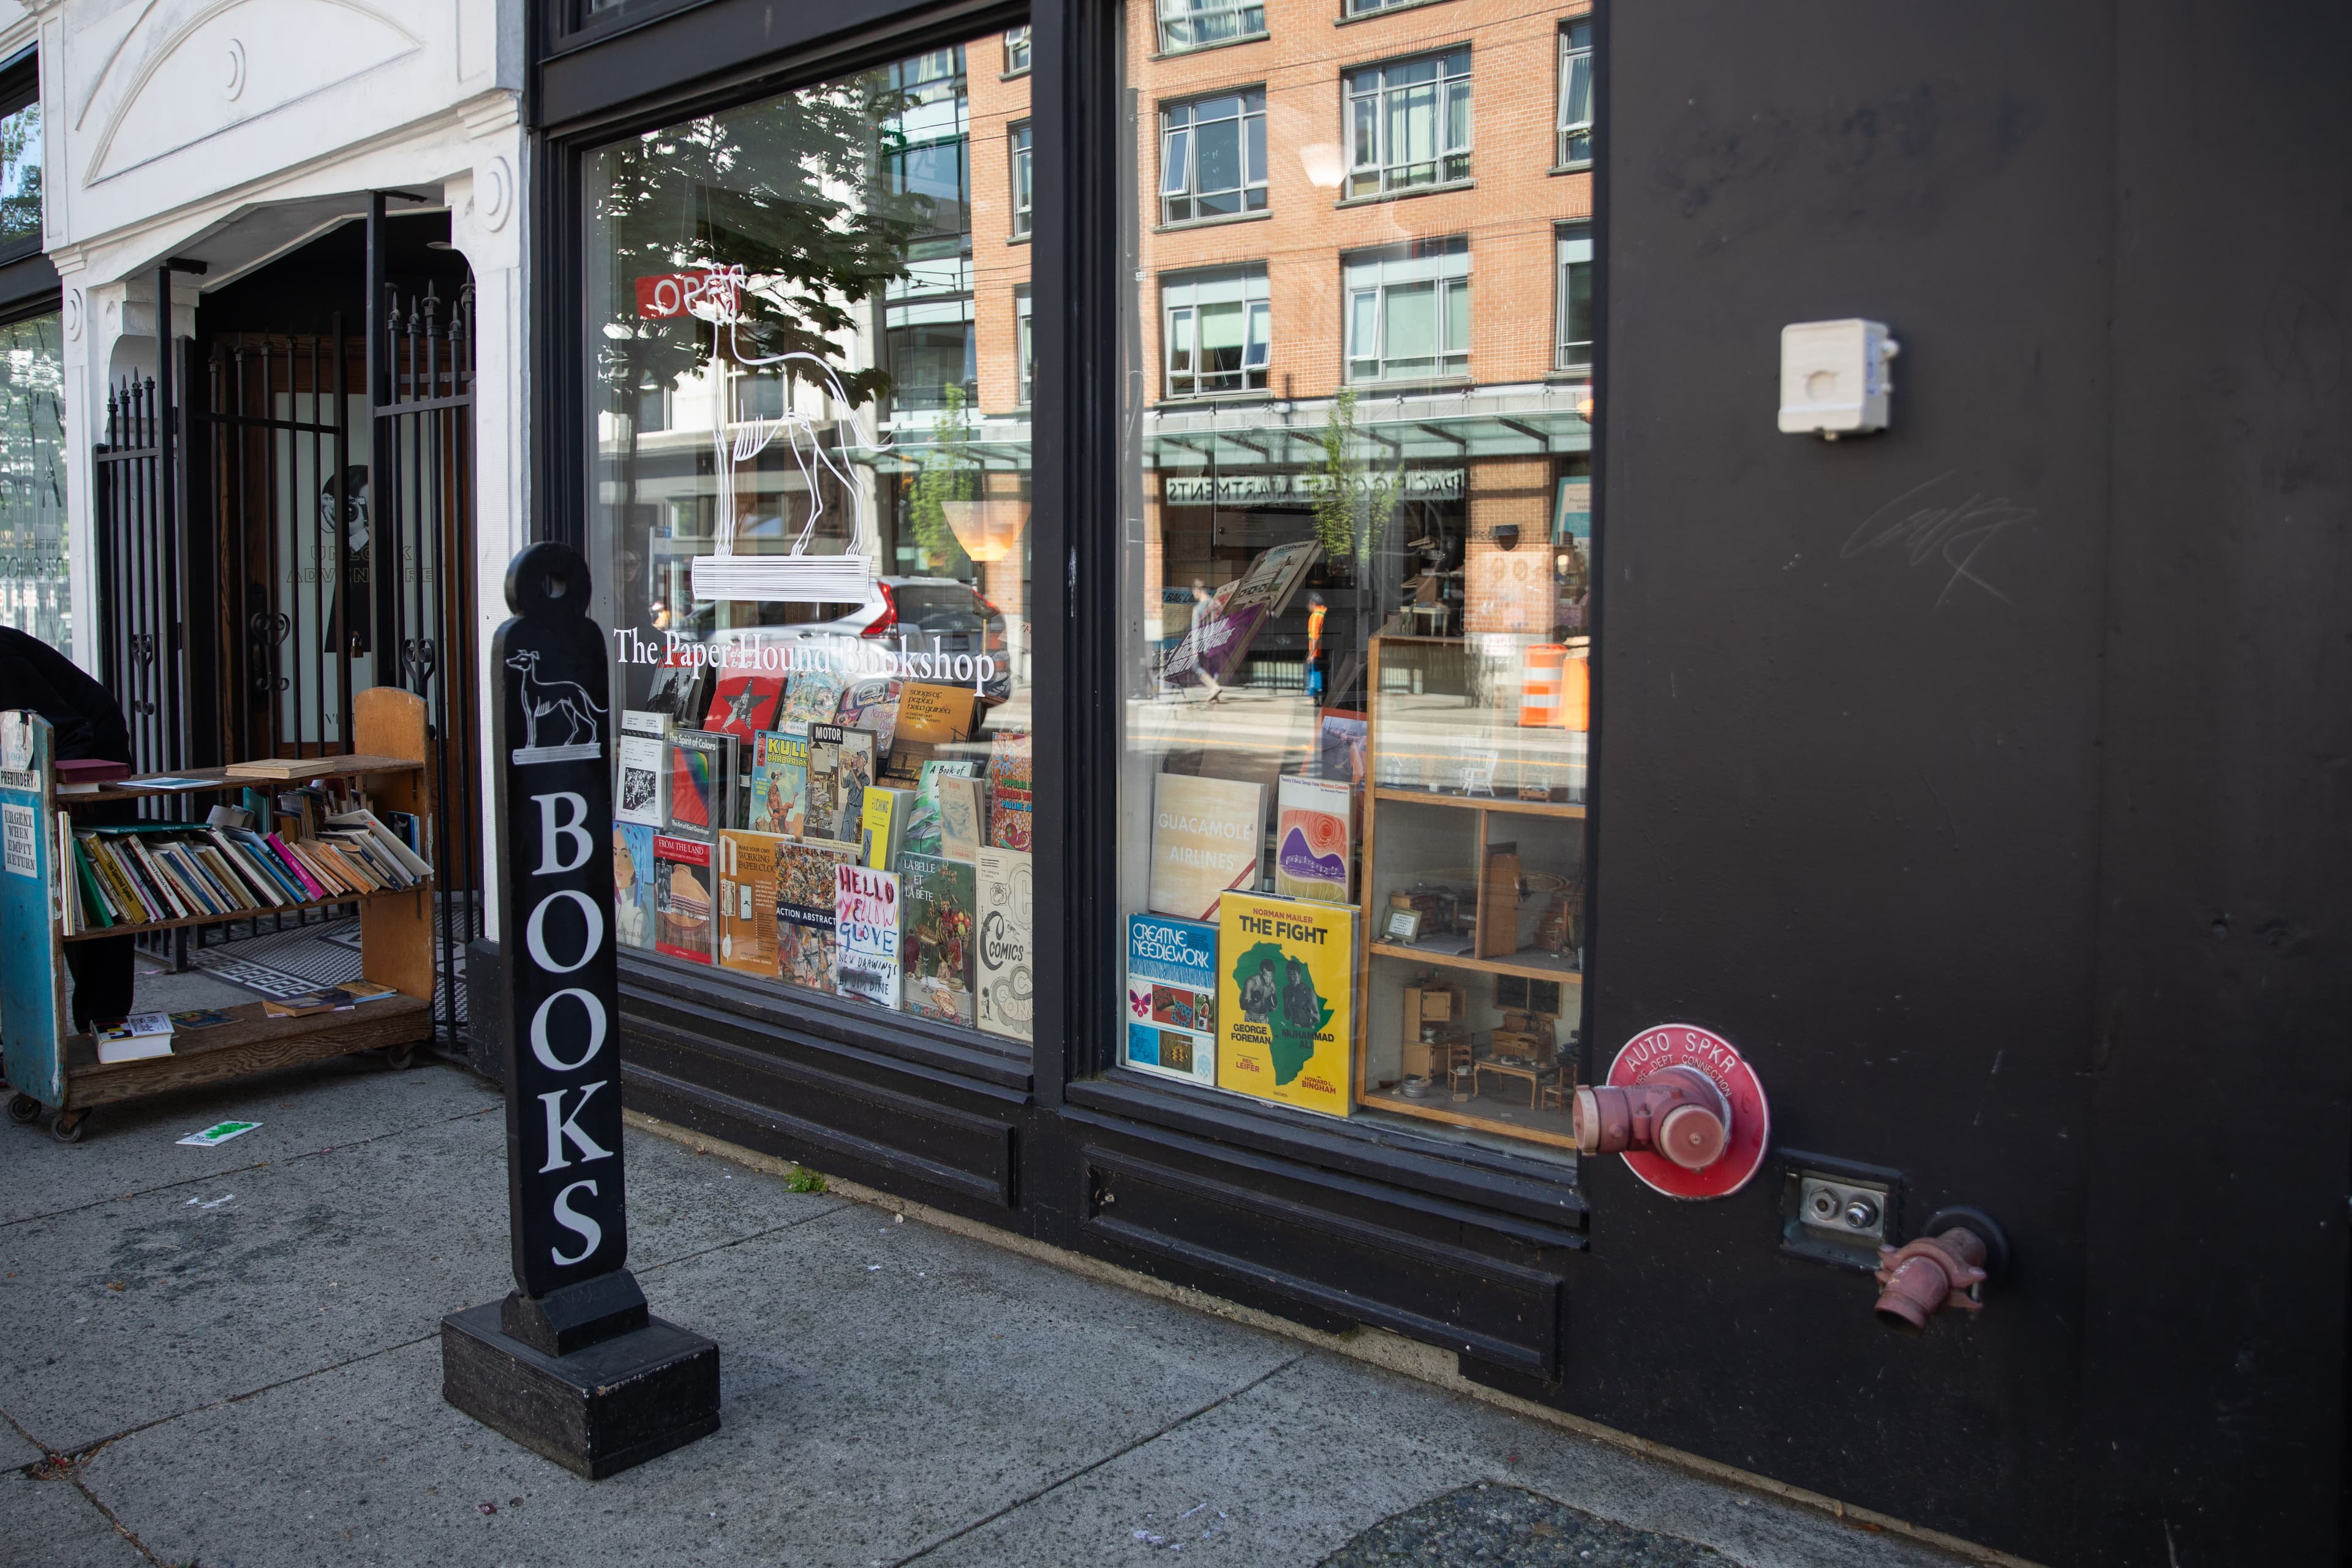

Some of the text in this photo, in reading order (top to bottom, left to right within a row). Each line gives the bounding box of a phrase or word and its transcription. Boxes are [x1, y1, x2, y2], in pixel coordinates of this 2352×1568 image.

[614, 627, 658, 665] The
[665, 630, 731, 680] Paper
[738, 632, 831, 673] Hound
[840, 634, 995, 698] Bookshop
[910, 689, 931, 698] songs
[925, 706, 951, 714] guinea
[815, 726, 842, 741] MOTOR
[678, 734, 692, 747] Spirit
[692, 737, 698, 747] of
[698, 738, 716, 751] Colors
[767, 737, 807, 759] KULL
[939, 765, 954, 774] Book
[957, 766, 965, 775] of
[1, 770, 34, 788] PREBINDERY
[1001, 800, 1023, 811] PAULINE
[5, 810, 33, 824] URGENT
[9, 826, 28, 839] WHEN
[1158, 813, 1250, 840] GUACAMOLE
[8, 839, 32, 854] EMPTY
[658, 839, 704, 855] FROM THE LAND
[7, 853, 34, 870] RETURN
[739, 851, 770, 862] WORKING
[1169, 845, 1235, 872] AIRLINES
[739, 861, 758, 871] PAPER
[904, 859, 935, 874] LA BELLE
[839, 865, 894, 904] HELLO
[914, 875, 922, 885] ET
[905, 886, 933, 902] LA BÊTE
[776, 907, 836, 926] ACTION ABSTRACT
[840, 895, 897, 928] YELLOW
[1253, 908, 1313, 924] NORMAN MAILER
[839, 922, 897, 953] GLOVE
[1133, 923, 1187, 947] CREATIVE
[1239, 915, 1328, 944] THE FIGHT
[989, 941, 1023, 961] COMICS
[1133, 939, 1209, 968] NEEDLEWORK
[869, 981, 889, 995] DINE
[526, 790, 614, 1267] BOOKS
[1233, 1023, 1267, 1035] GEORGE
[1282, 1029, 1334, 1042] MUHAMMAD
[1231, 1033, 1271, 1044] FOREMAN
[1300, 1041, 1313, 1049] ALI
[1626, 1032, 1736, 1073] AUTO SPKR
[1236, 1062, 1259, 1073] LEIFER
[1304, 1076, 1327, 1085] HOWARD
[1682, 1055, 1732, 1098] CONNECTION
[1302, 1080, 1336, 1095] BINGHAM
